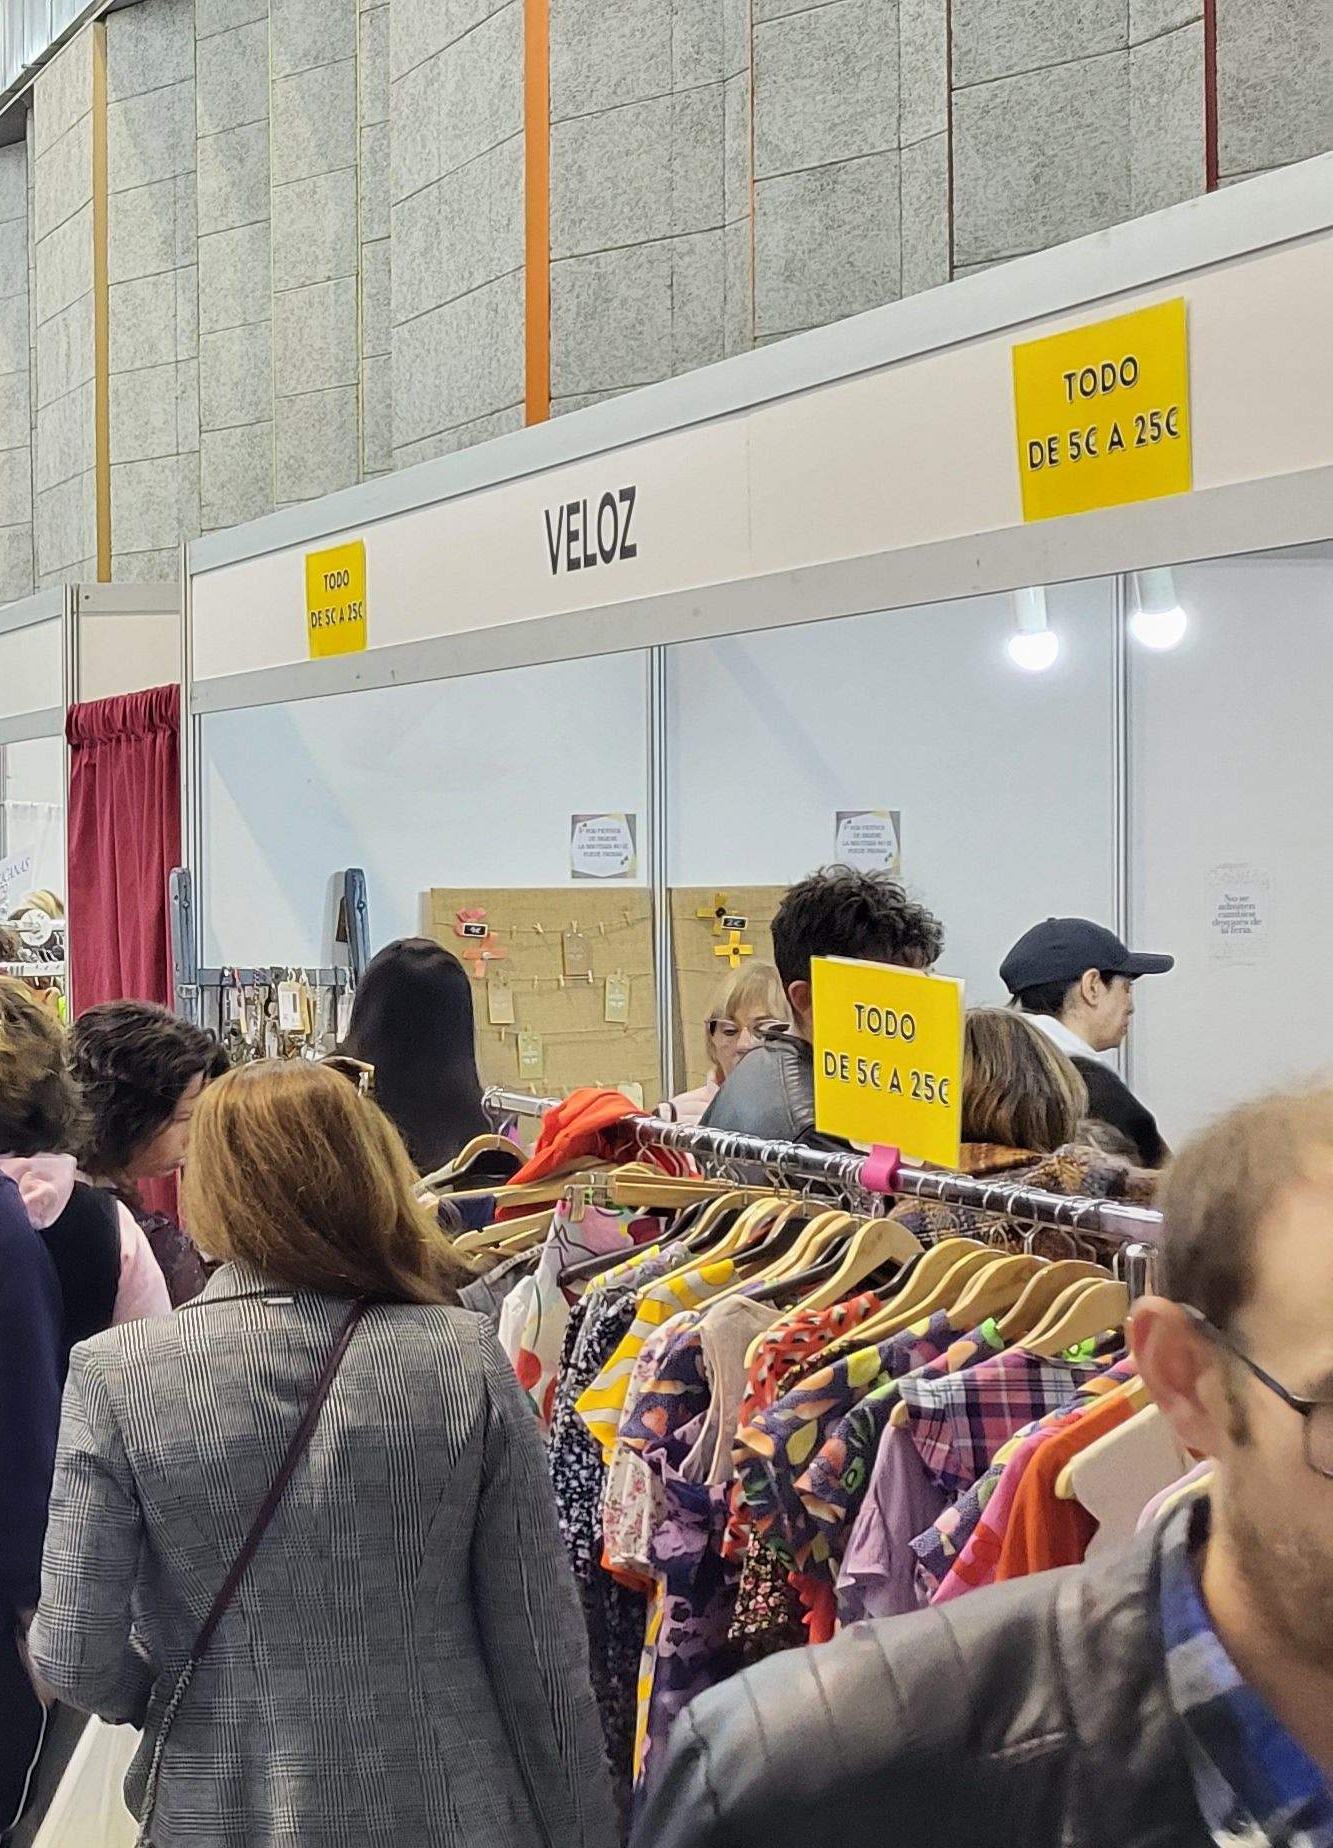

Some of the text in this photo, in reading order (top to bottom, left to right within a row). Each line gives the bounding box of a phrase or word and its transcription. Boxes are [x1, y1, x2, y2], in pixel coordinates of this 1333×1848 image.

[1064, 356, 1139, 402] TODO
[1028, 406, 1180, 468] DE 5€ A 25€
[544, 485, 637, 575] VELOZ
[323, 569, 350, 592] TODO
[311, 601, 363, 628] DE 5€ A 25€
[1224, 894, 1238, 902] No
[854, 1003, 916, 1041] TODO
[824, 1051, 950, 1105] DE 5€ A 25€
